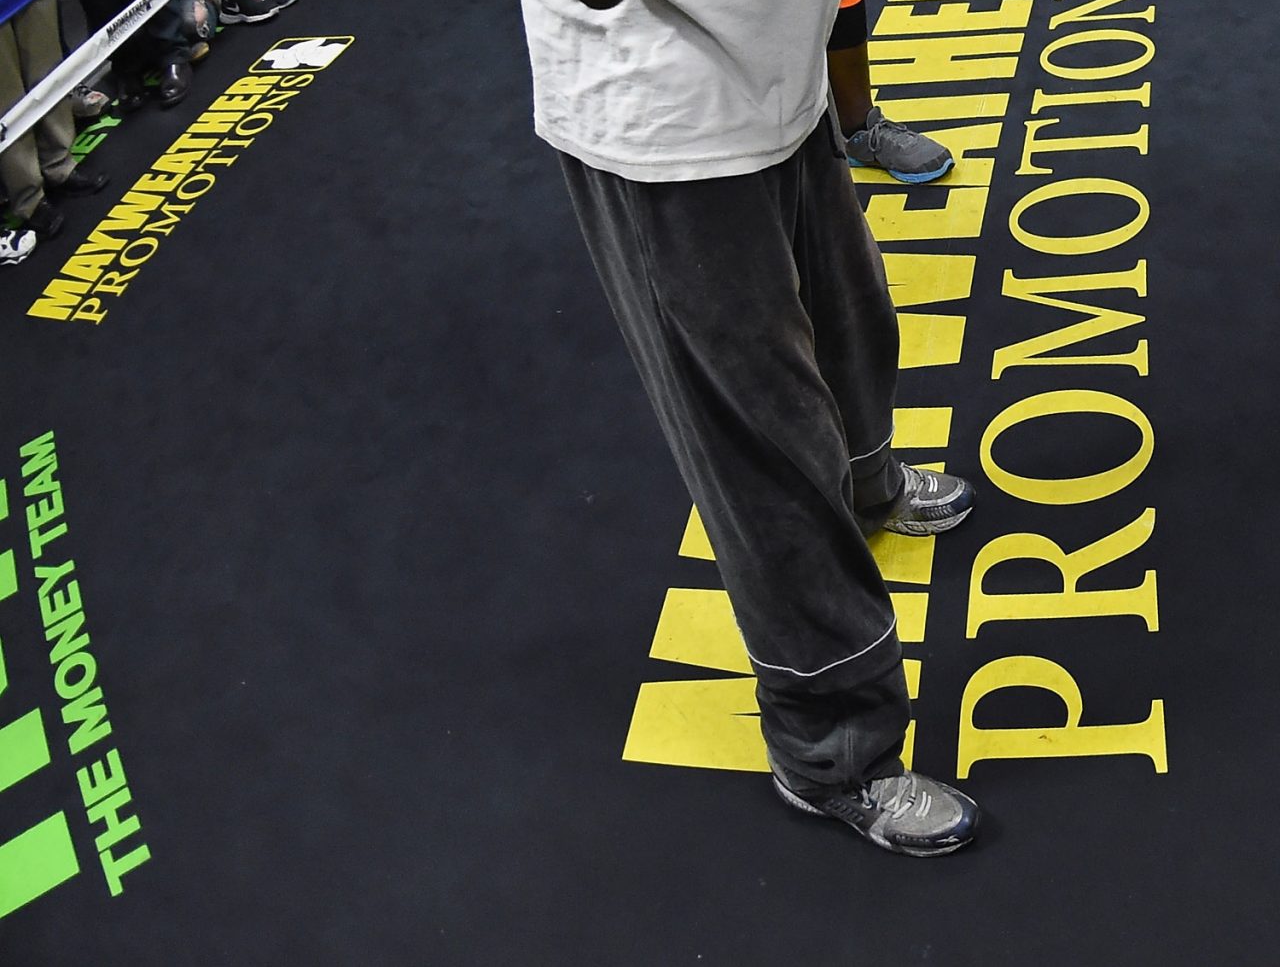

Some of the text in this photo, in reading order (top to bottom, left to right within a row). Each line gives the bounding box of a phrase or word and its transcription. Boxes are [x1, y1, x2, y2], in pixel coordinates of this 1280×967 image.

[26, 75, 282, 321] MAYWEATHER
[71, 73, 315, 325] PROMOTIONS
[19, 430, 69, 560] TEAM
[34, 559, 112, 755] MONEY
[76, 747, 151, 897] THE
